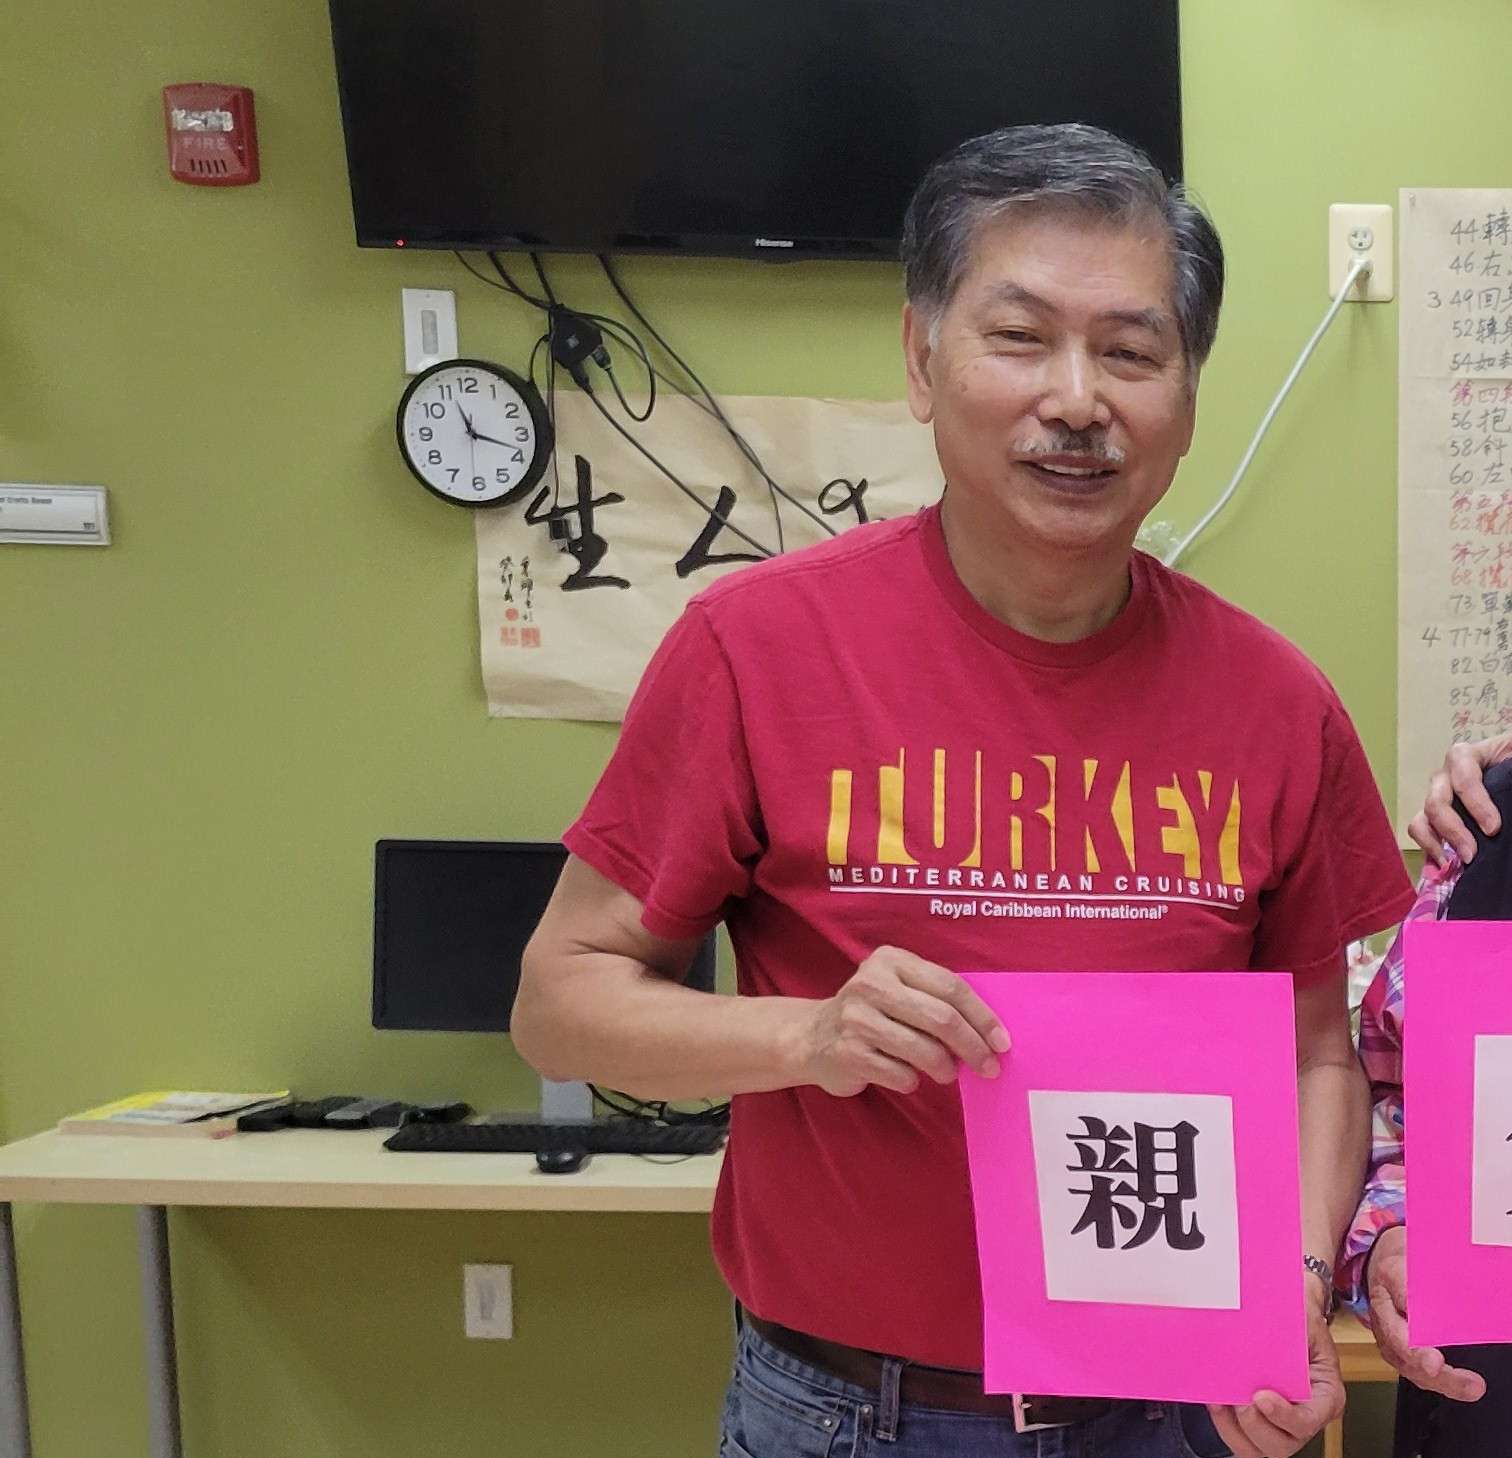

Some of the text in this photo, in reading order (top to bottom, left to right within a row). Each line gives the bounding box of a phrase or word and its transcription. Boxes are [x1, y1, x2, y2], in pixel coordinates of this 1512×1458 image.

[438, 384, 453, 400] 11
[456, 377, 479, 394] 12
[489, 384, 497, 399] 1
[422, 402, 446, 420] 10
[504, 402, 520, 419] 2
[418, 426, 433, 442] 9
[513, 426, 530, 443] 3
[428, 449, 442, 465] 8
[510, 448, 525, 464] 4
[445, 468, 460, 483] 7
[471, 476, 486, 491] 6
[496, 468, 511, 484] 5
[829, 867, 1246, 903] MEDITERRANEAN CRUISING
[930, 899, 976, 918] Royal
[980, 901, 1062, 918] Caribbean
[1066, 1116, 1205, 1250] 親
